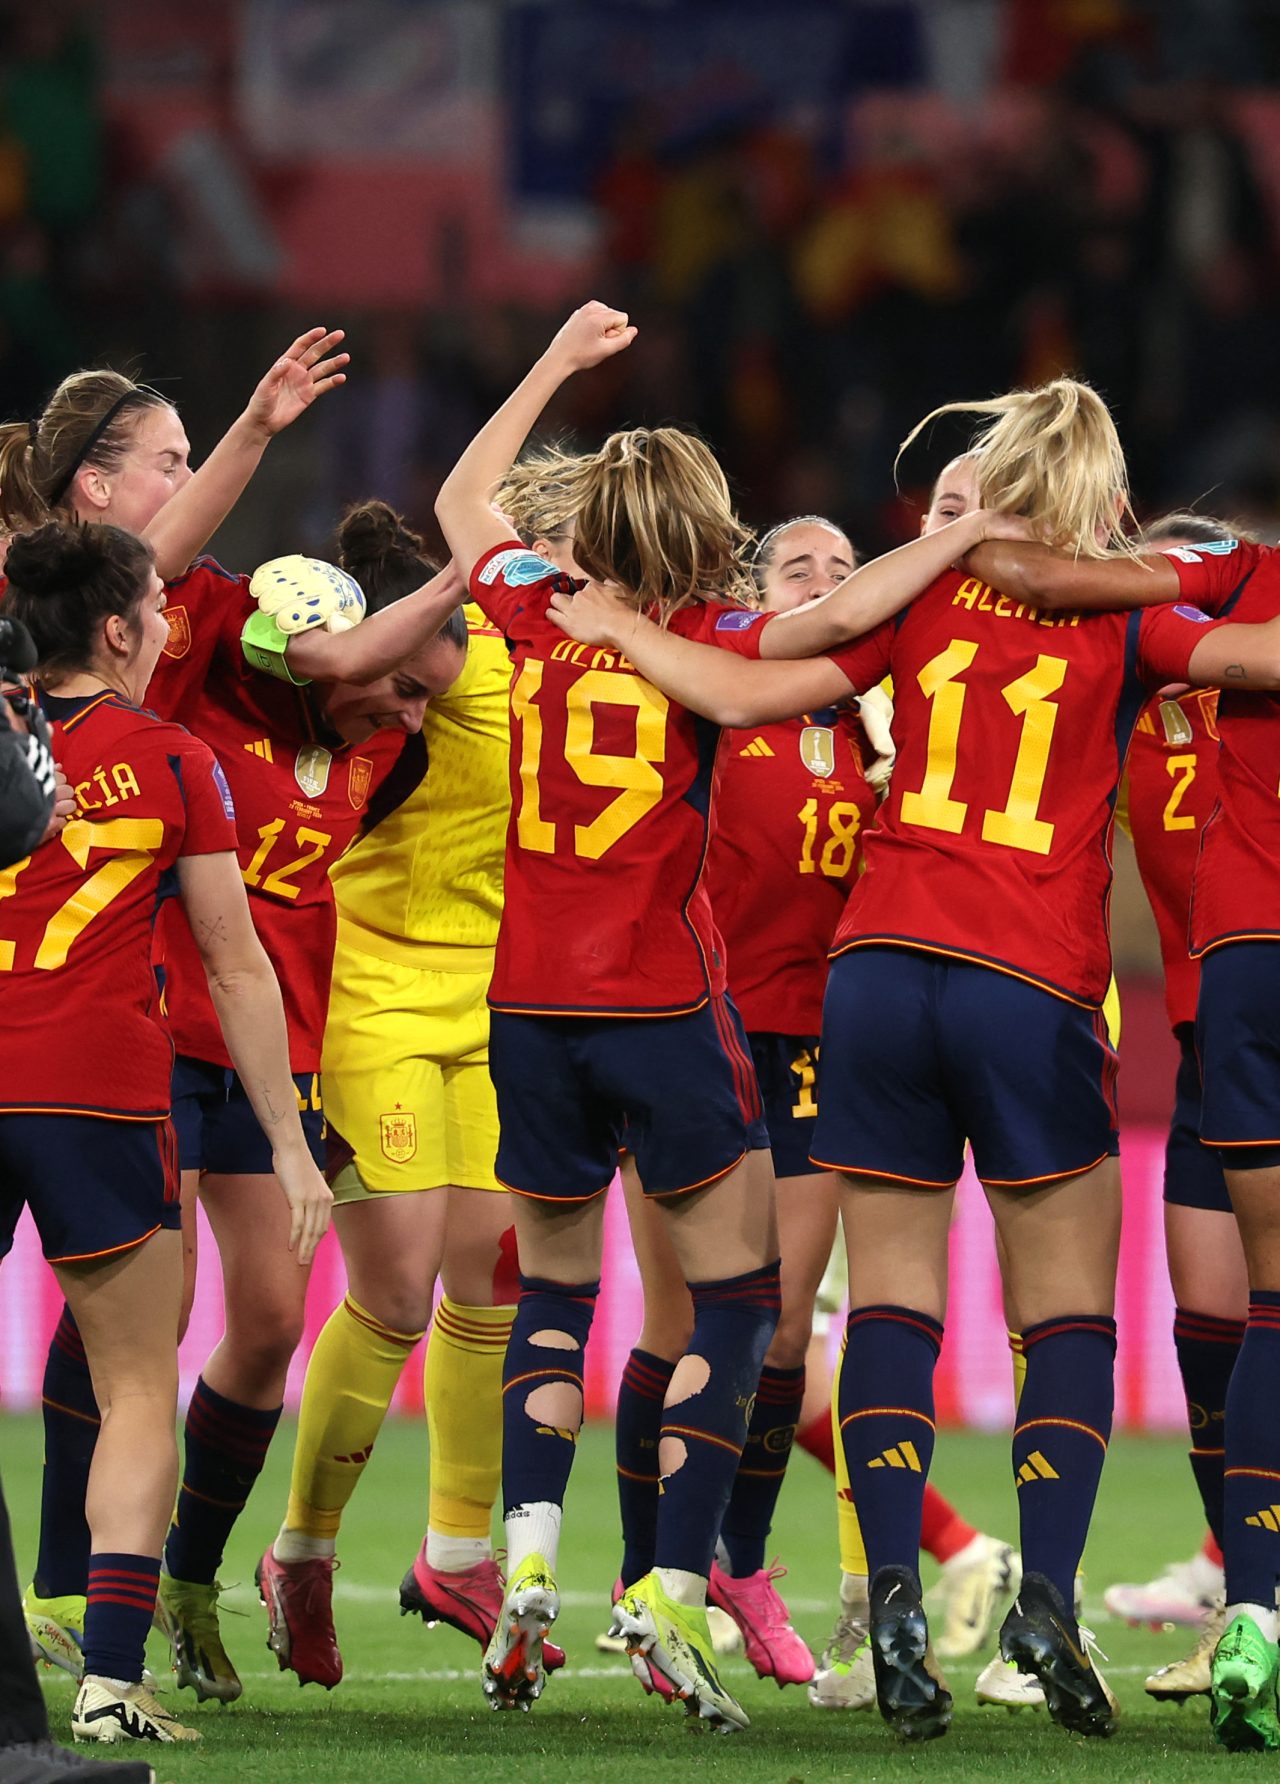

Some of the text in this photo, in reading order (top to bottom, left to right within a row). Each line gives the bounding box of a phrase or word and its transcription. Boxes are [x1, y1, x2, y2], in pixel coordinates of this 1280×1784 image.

[952, 577, 1079, 627] ALE
[511, 657, 669, 860] 19
[900, 639, 1068, 856] 11
[66, 763, 141, 820] CÍA
[1163, 754, 1197, 831] 2
[241, 817, 332, 899] 12
[797, 798, 861, 878] 18
[790, 1046, 820, 1119] 1
